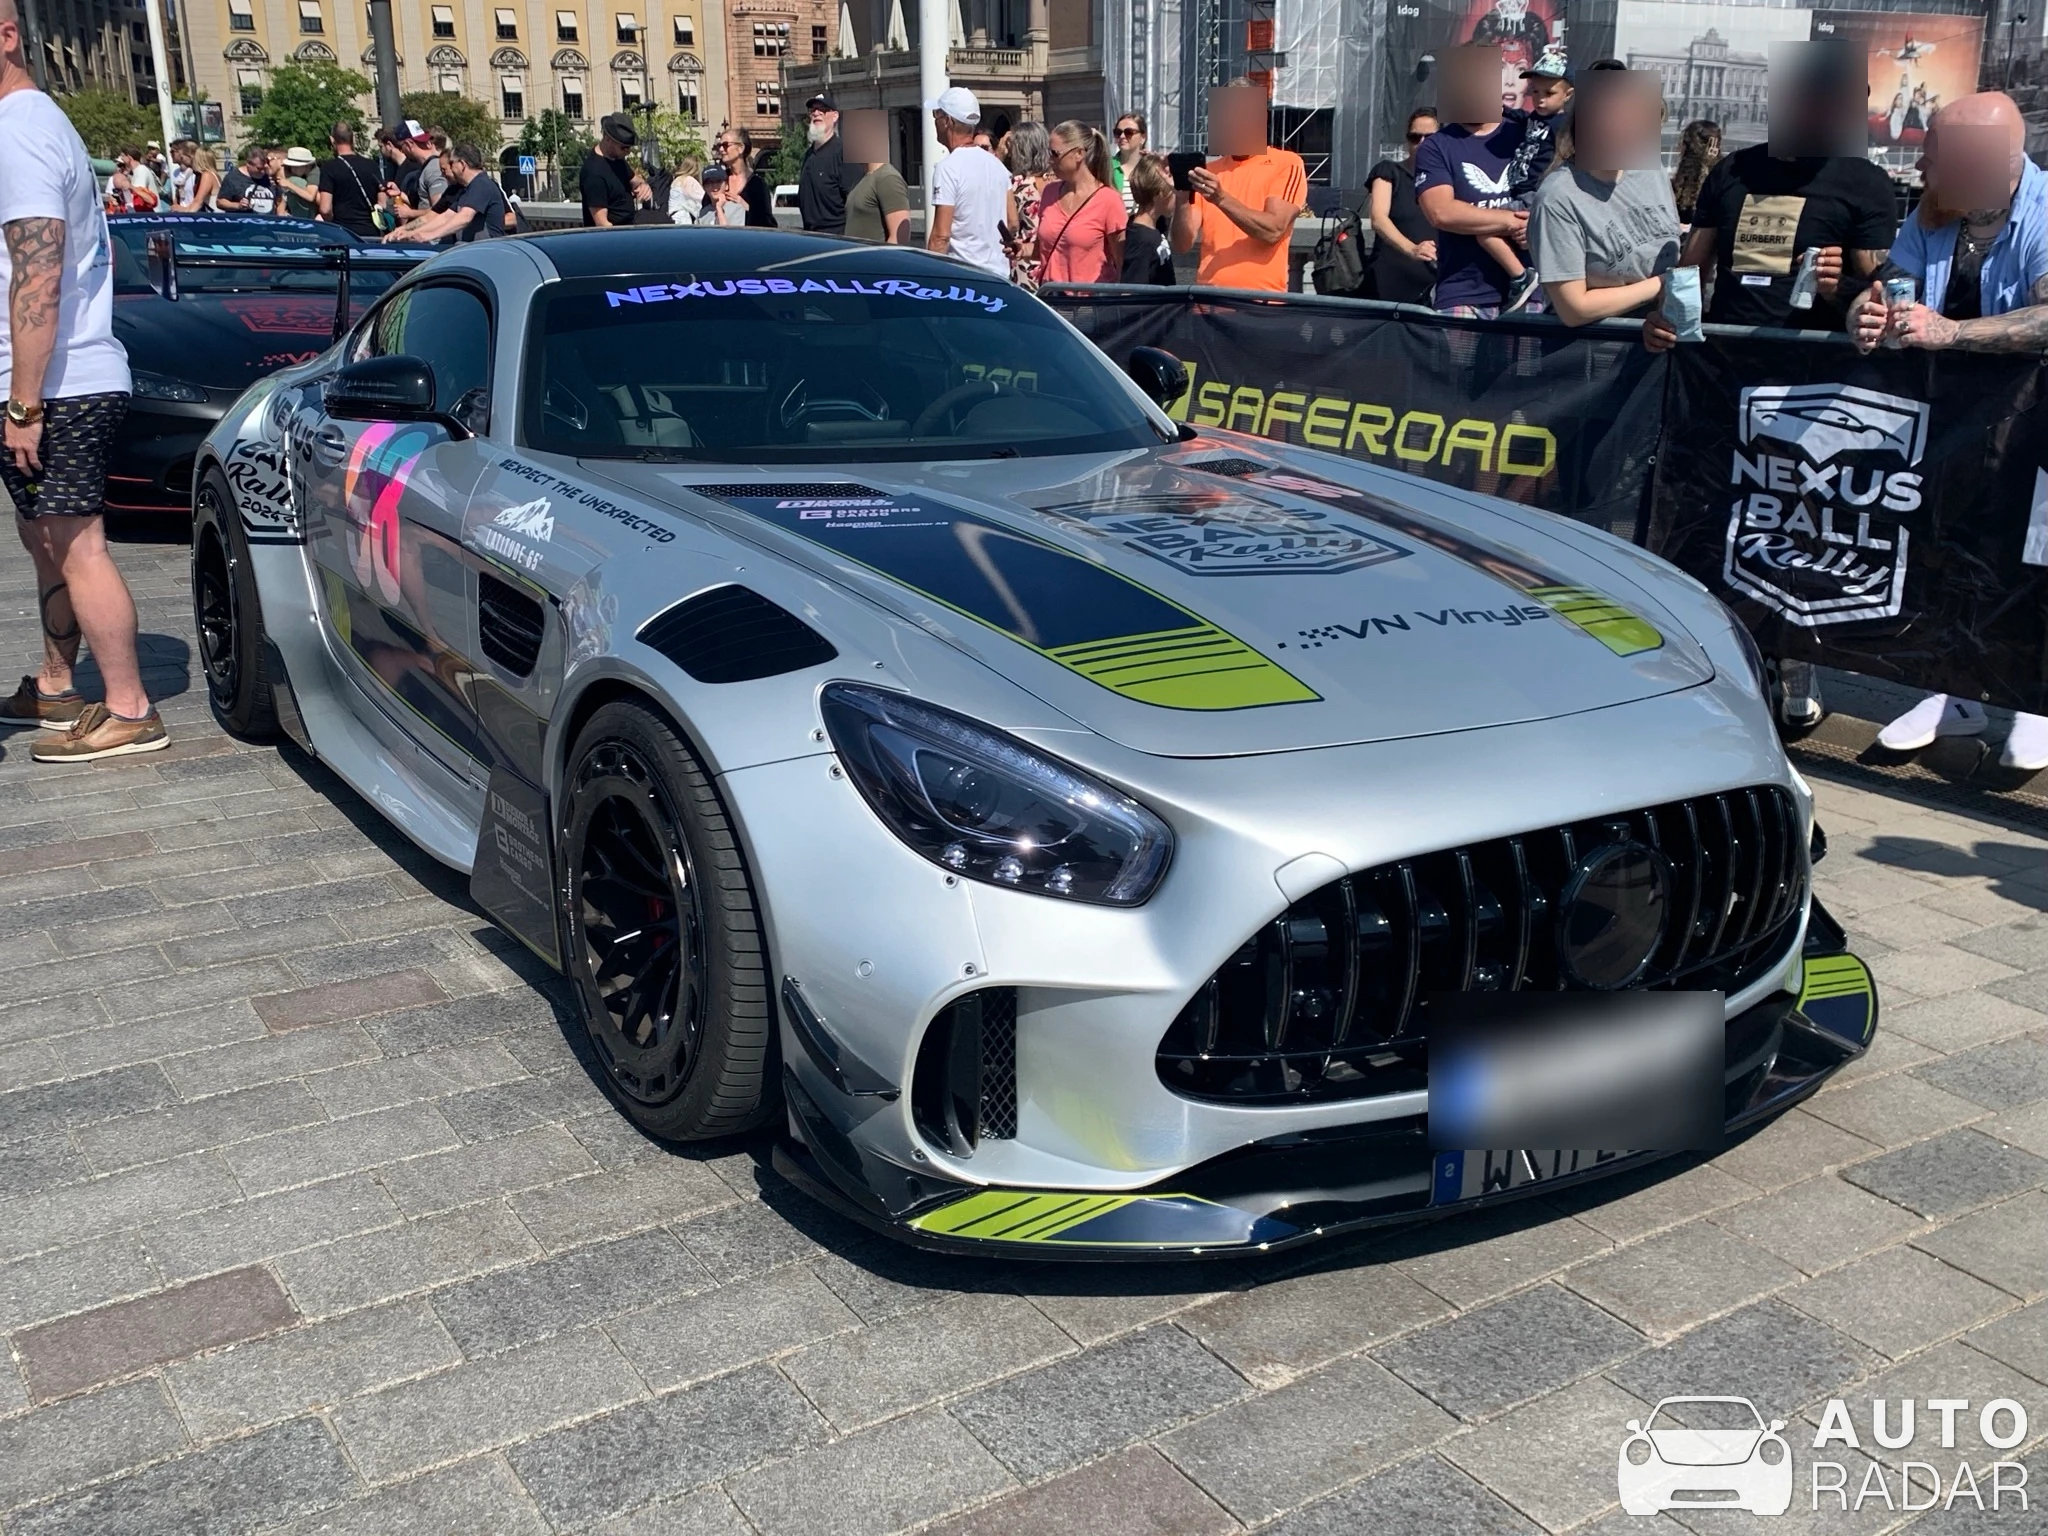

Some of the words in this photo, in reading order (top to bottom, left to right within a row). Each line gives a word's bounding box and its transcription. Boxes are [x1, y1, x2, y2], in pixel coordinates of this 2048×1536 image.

[1740, 233, 1788, 245] BURBERRY
[1194, 381, 1557, 477] SAFEROAD
[1731, 449, 1924, 512] NEXUS
[240, 496, 281, 523] 2024
[551, 481, 583, 499] THE
[578, 493, 676, 543] UNEXPECTED
[1745, 493, 1892, 550] BALL
[485, 528, 527, 564] LATITUDE
[1134, 524, 1341, 549] BALL
[1169, 536, 1369, 562] Rally
[1256, 549, 1338, 562] 2024
[1735, 532, 1890, 594] Rally
[1332, 614, 1411, 639] VN
[1414, 605, 1550, 626] Vinyls
